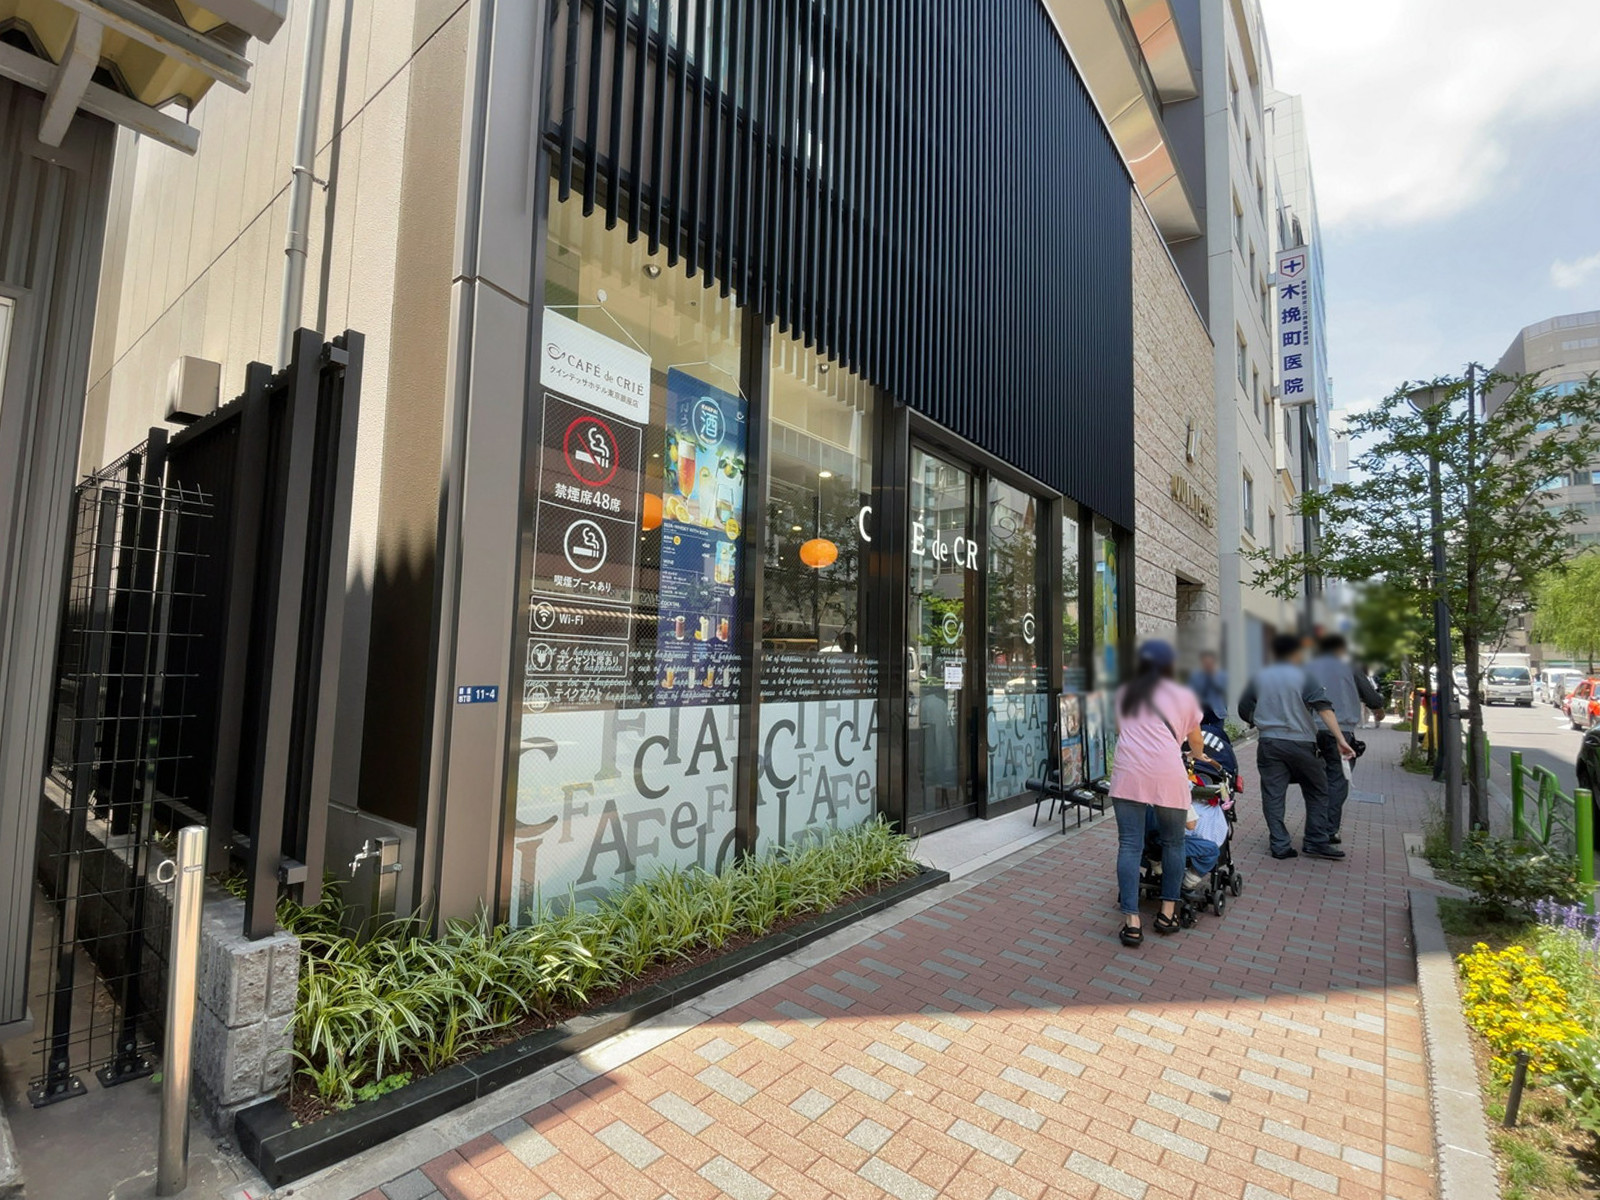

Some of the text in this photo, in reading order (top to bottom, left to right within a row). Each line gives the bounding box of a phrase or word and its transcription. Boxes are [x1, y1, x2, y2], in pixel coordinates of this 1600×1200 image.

[1281, 283, 1303, 394] 木挽町医院
[568, 354, 644, 396] CAFÉ de CRIÉ
[555, 482, 621, 513] 禁煙席48席
[932, 528, 948, 562] de
[953, 535, 979, 571] CR
[553, 574, 612, 593] 喫煙ブースあり
[559, 614, 584, 626] Wi-Fi
[476, 689, 495, 700] 11-4
[554, 687, 602, 699] テイクアウト
